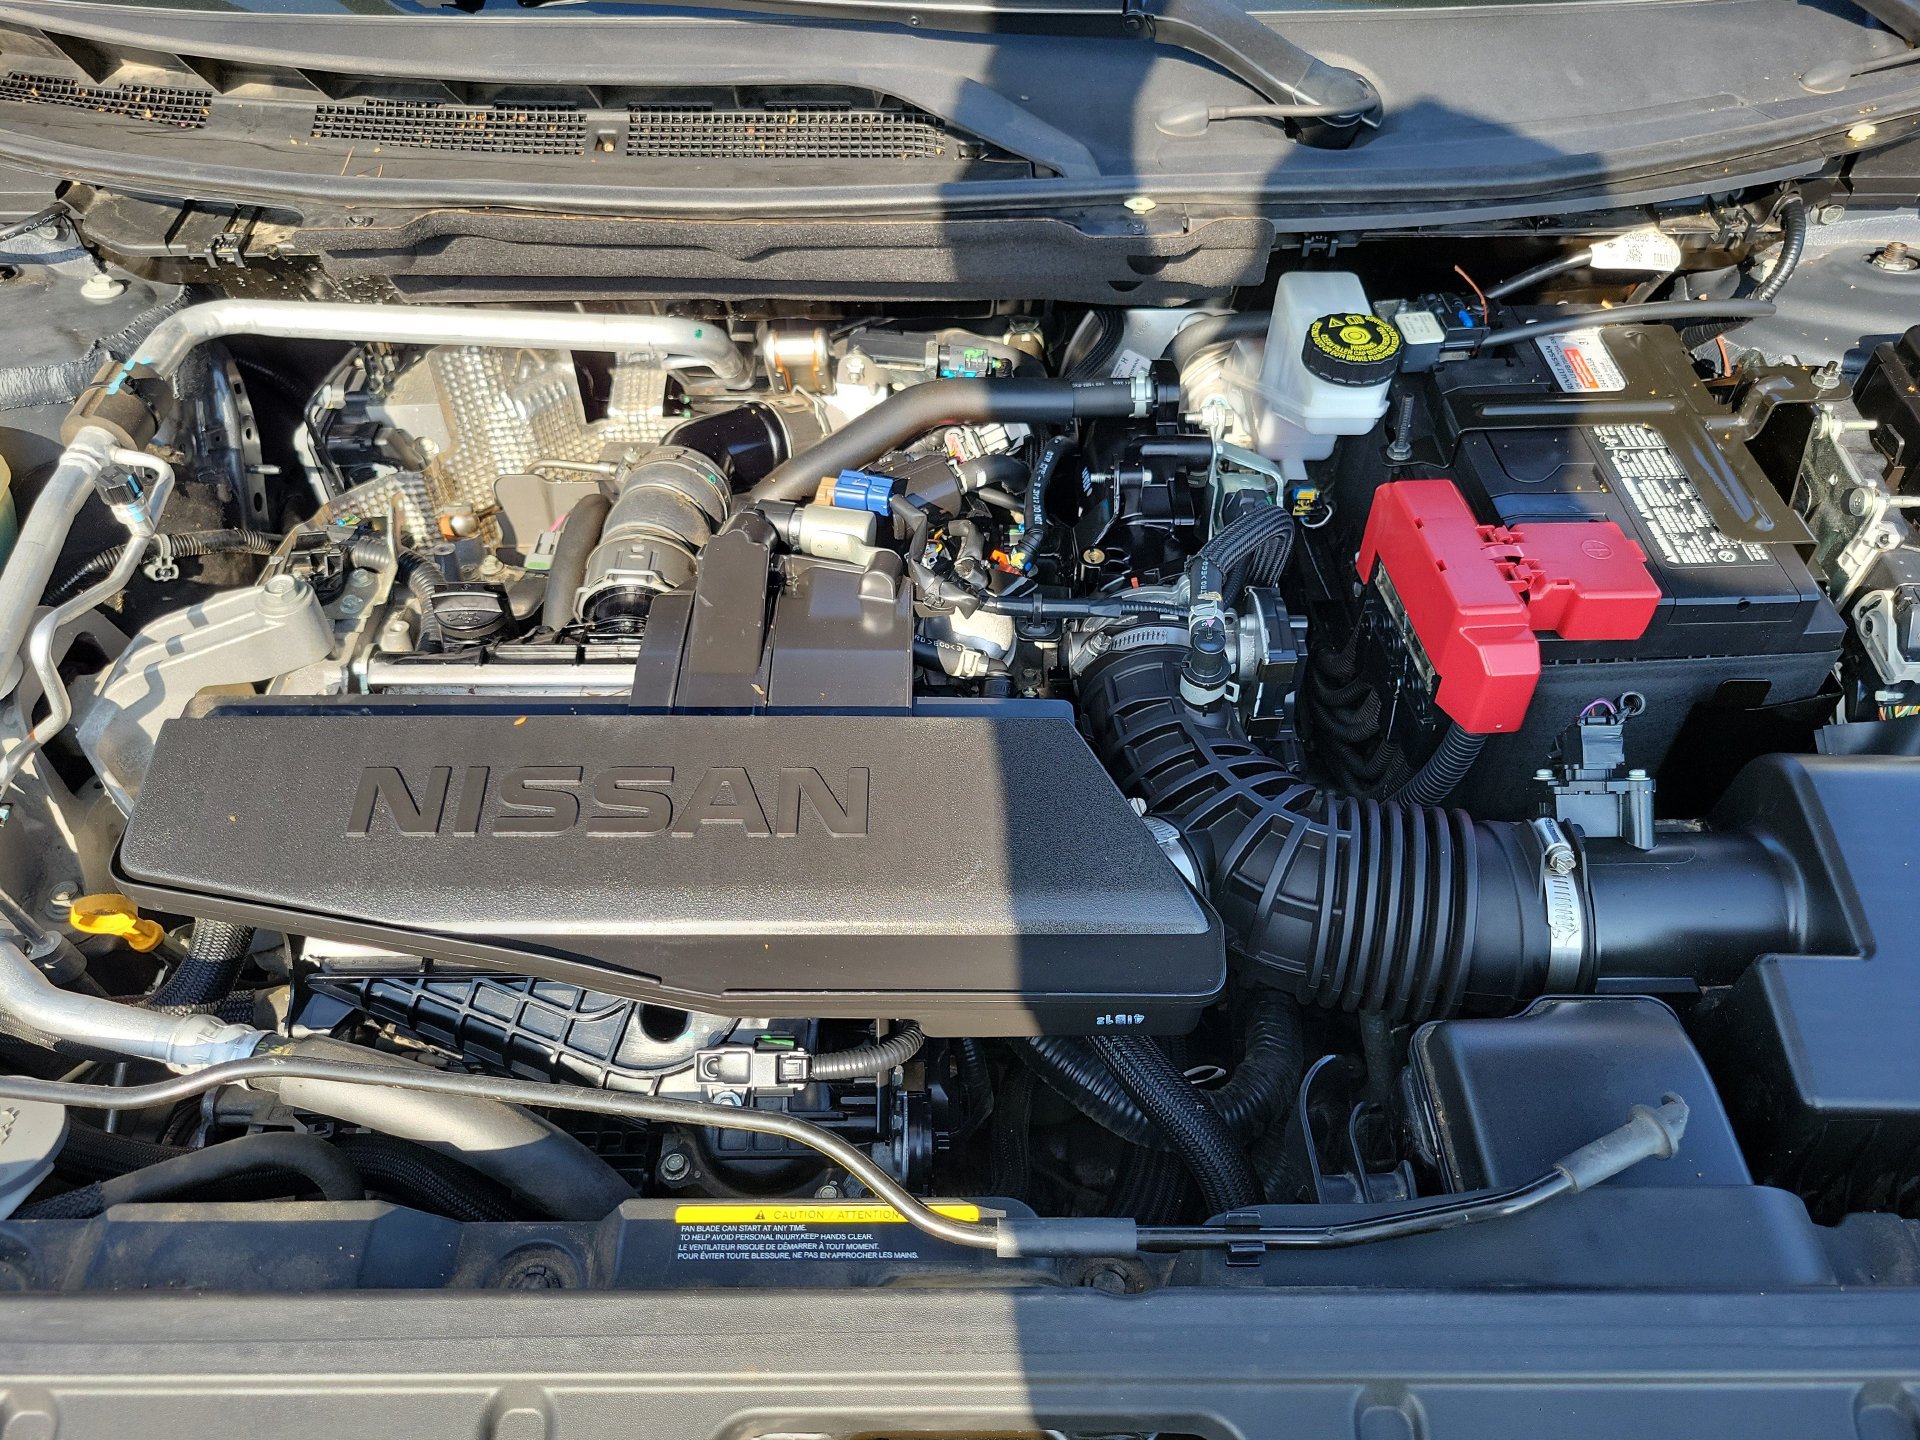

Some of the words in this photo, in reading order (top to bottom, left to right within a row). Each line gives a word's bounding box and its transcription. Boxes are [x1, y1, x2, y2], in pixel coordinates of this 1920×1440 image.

[1345, 353, 1369, 362] BRAKE
[346, 766, 870, 837] NISSAN
[773, 1210, 824, 1220] CAUTION
[838, 1210, 900, 1220] ATTENTION
[772, 1224, 787, 1232] ANY
[691, 1233, 711, 1241] HELP
[711, 1233, 735, 1241] AVOID
[735, 1233, 774, 1241] PERSONAL
[679, 1243, 688, 1251] LE
[689, 1243, 736, 1251] VENTILATEUR
[736, 1243, 765, 1251] RISQUE
[777, 1242, 817, 1250] DÉMARRER
[818, 1241, 825, 1250] À
[677, 1252, 701, 1260] POUR
[700, 1251, 725, 1260] ÉVITER
[751, 1252, 791, 1260] BLESSURE,
